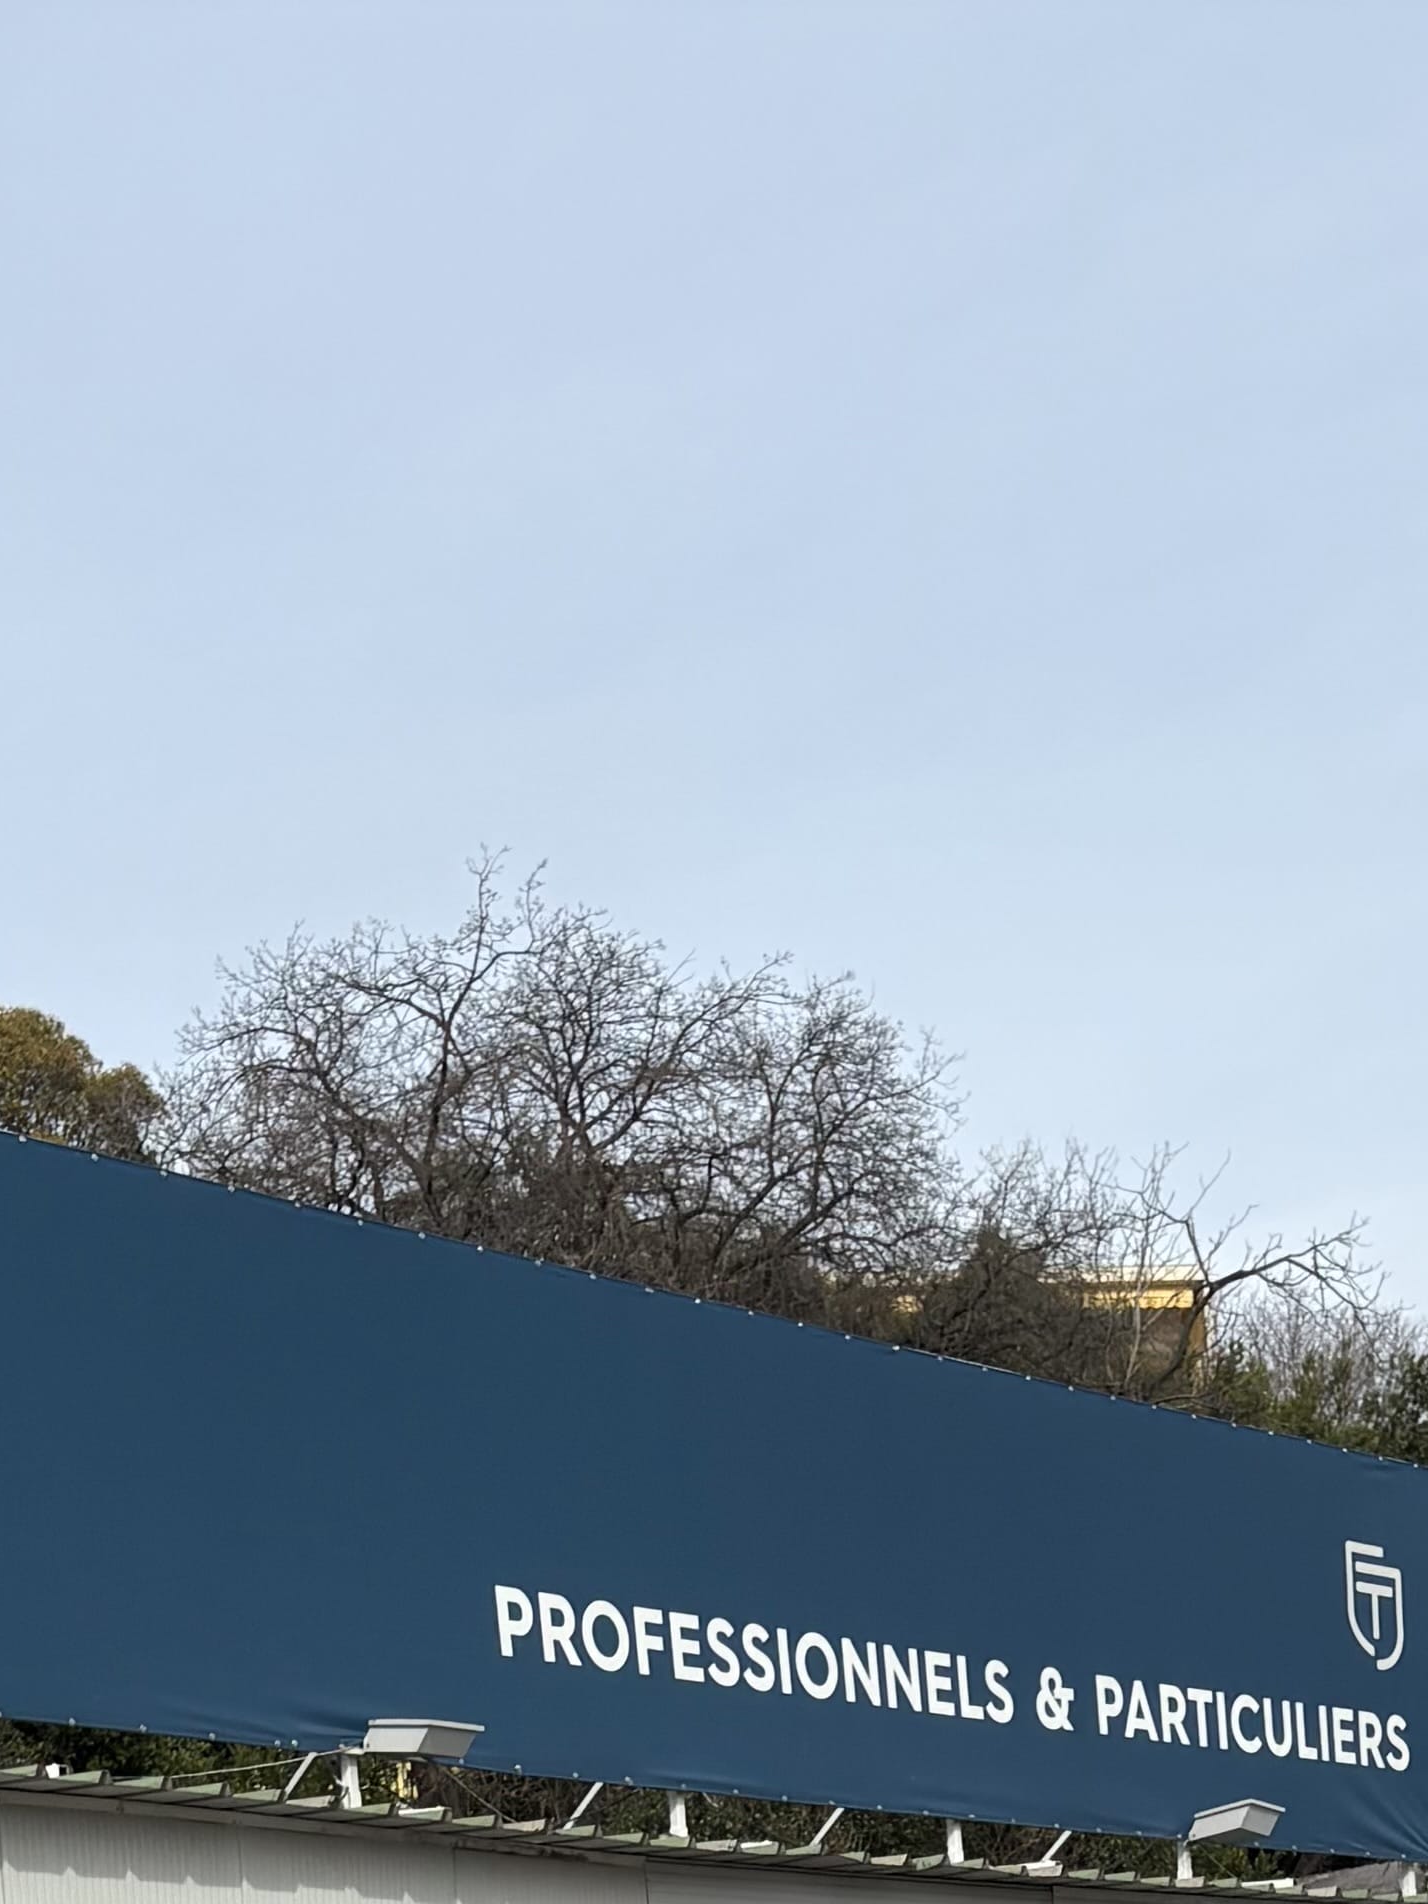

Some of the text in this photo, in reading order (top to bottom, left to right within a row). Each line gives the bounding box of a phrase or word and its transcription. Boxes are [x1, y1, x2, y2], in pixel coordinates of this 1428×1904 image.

[494, 1584, 1410, 1772] PROFESSIONNELS & PARTICULIERS
